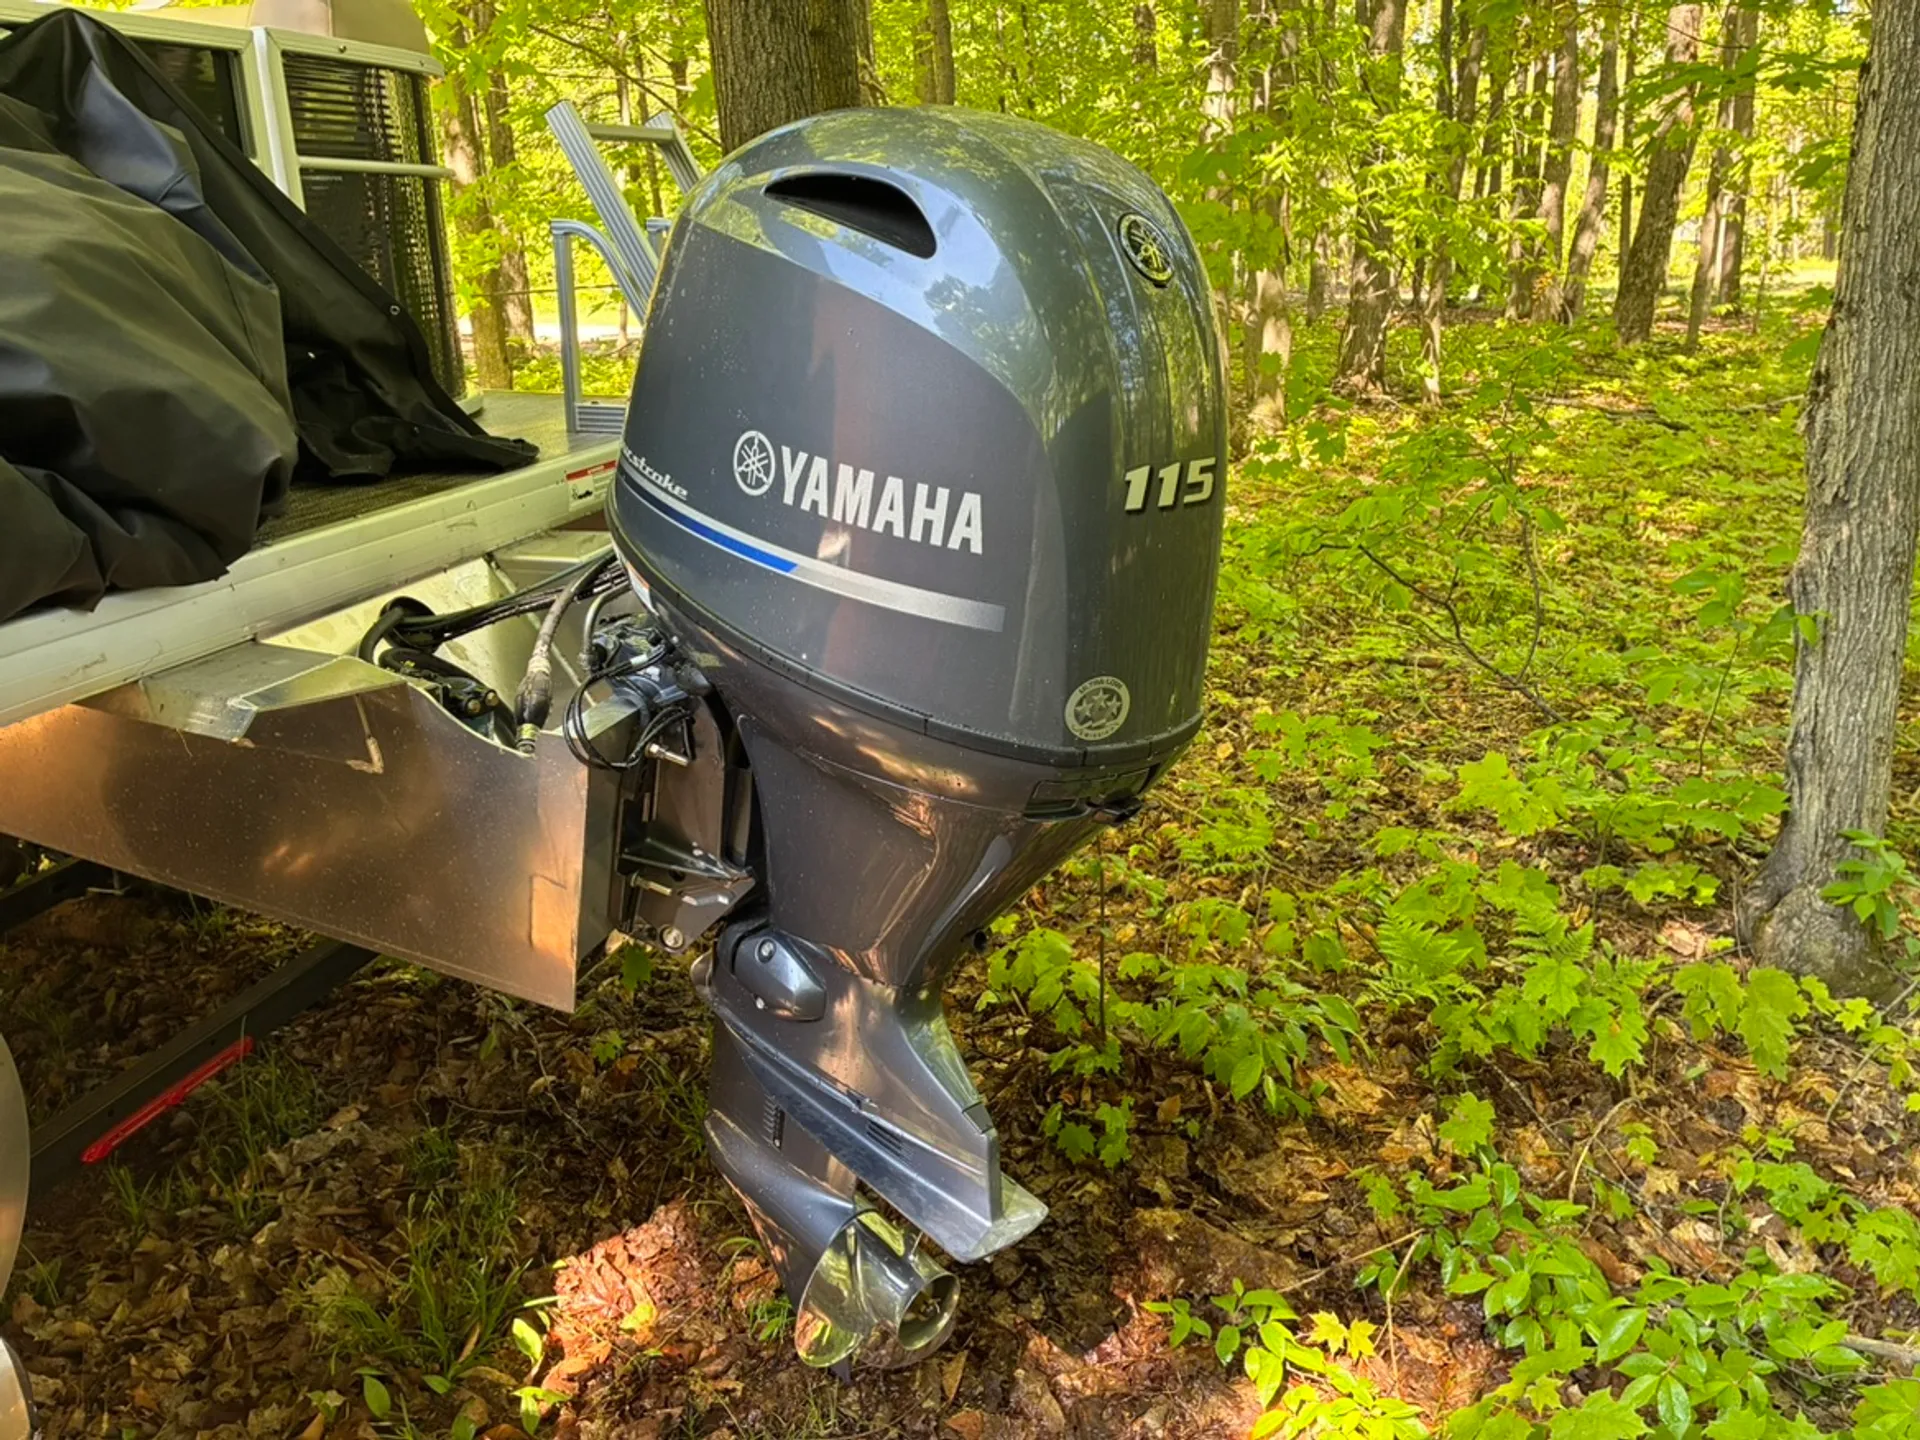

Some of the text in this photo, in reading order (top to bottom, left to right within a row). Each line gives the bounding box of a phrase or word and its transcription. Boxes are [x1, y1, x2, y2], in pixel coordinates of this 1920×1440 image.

[623, 447, 688, 500] stroke
[781, 446, 984, 555] YAMAHA
[1124, 456, 1217, 512] 115
